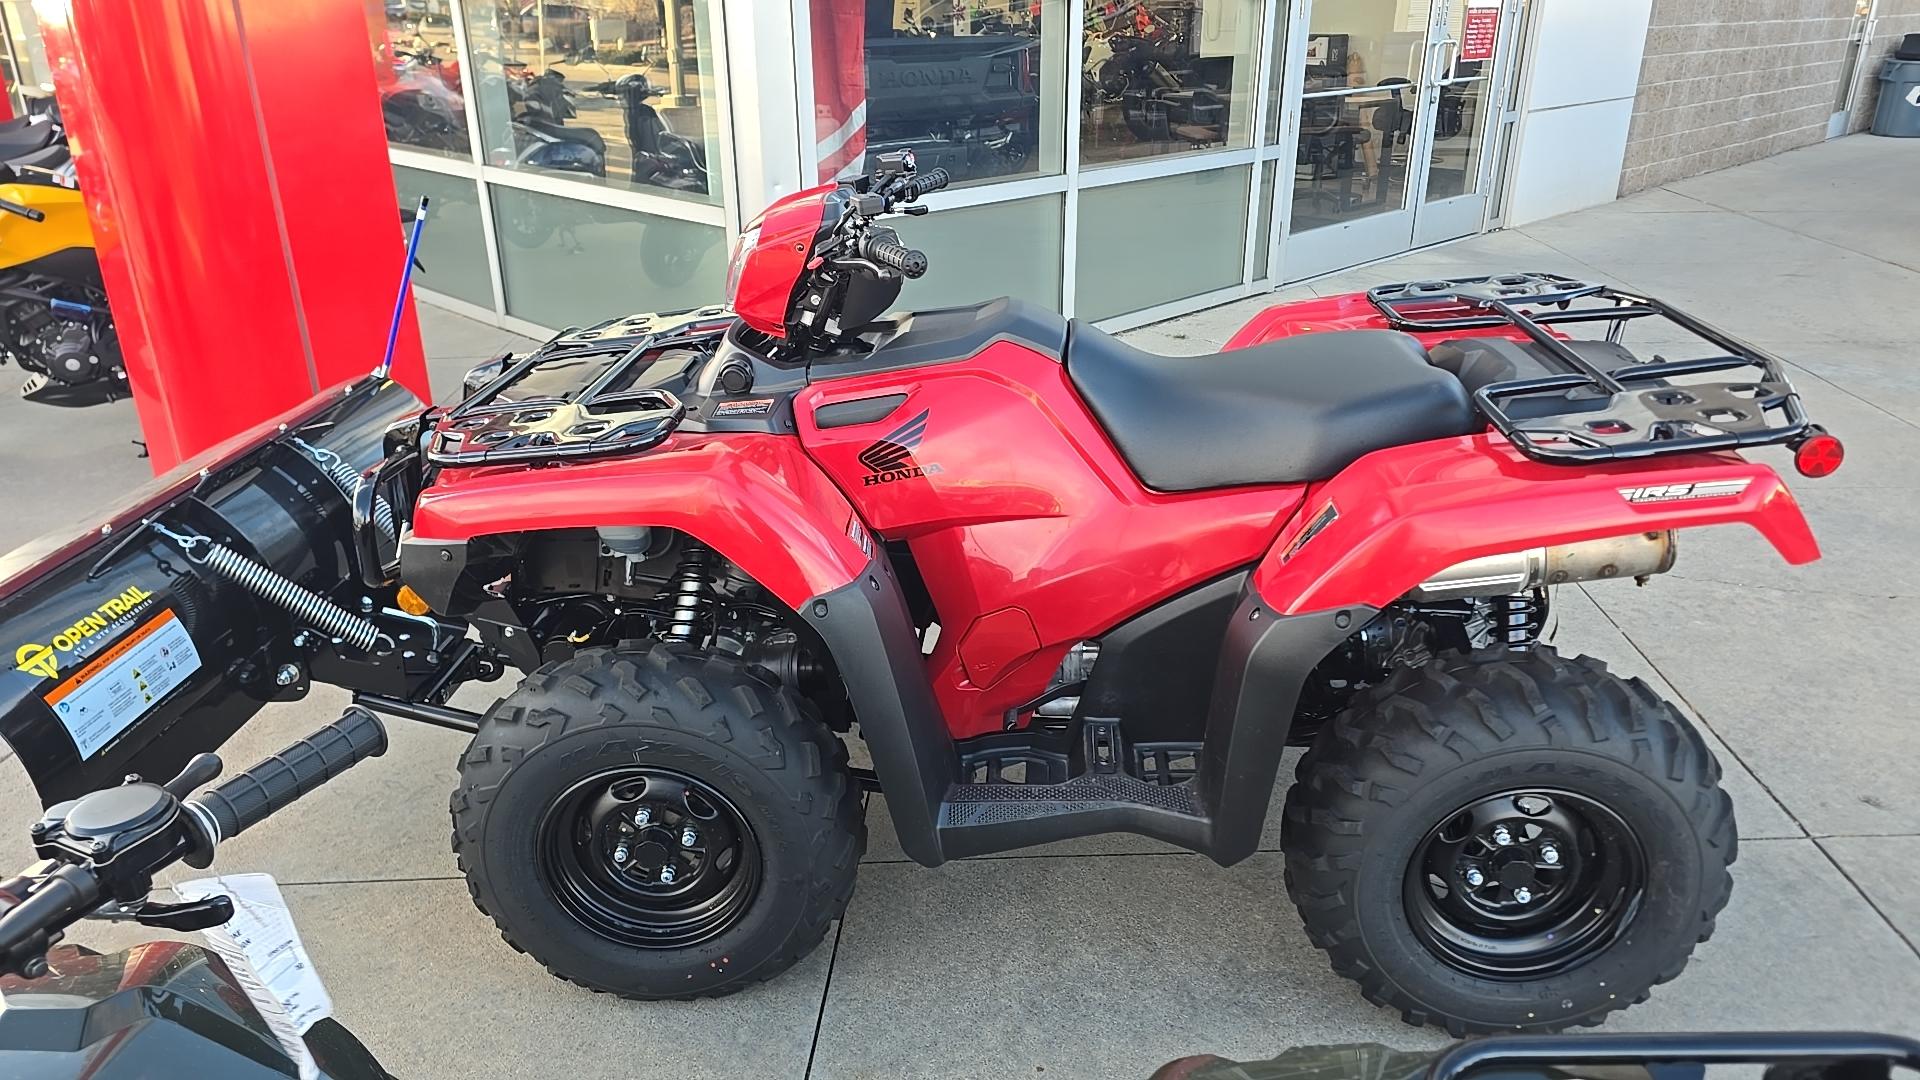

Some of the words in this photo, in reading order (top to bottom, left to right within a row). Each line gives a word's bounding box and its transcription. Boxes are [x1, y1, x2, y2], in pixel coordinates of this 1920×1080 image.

[879, 67, 978, 89] HONDA
[862, 462, 945, 487] HONDA
[1631, 483, 1694, 499] IRS
[52, 611, 108, 652] OPEN
[97, 585, 154, 620] TRAIL
[73, 644, 87, 656] ATV
